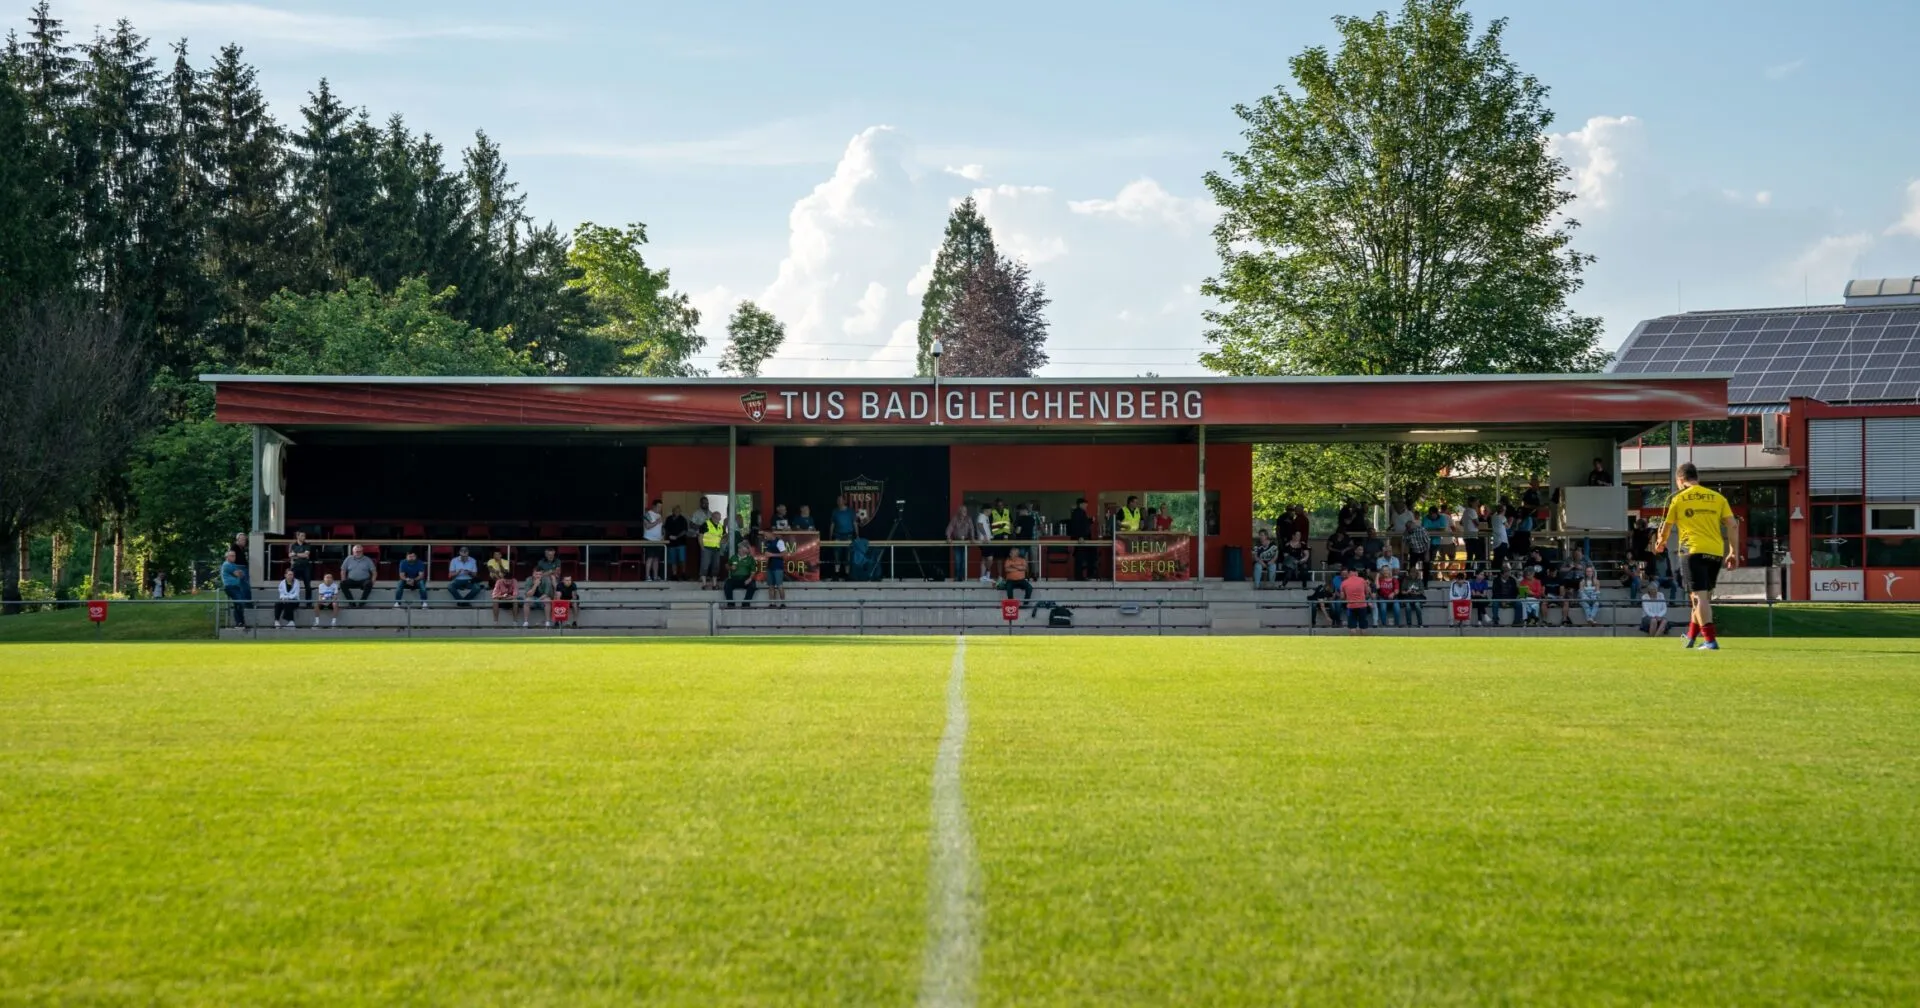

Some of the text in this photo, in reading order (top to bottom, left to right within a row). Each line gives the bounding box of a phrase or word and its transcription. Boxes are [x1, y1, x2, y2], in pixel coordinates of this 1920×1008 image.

[780, 390, 1204, 420] TUS BAD GLEICHENBERG
[849, 493, 872, 502] TUS
[1131, 541, 1167, 553] HEIM
[1121, 560, 1175, 573] SEKTOR
[1814, 579, 1860, 592] LEOFIT
